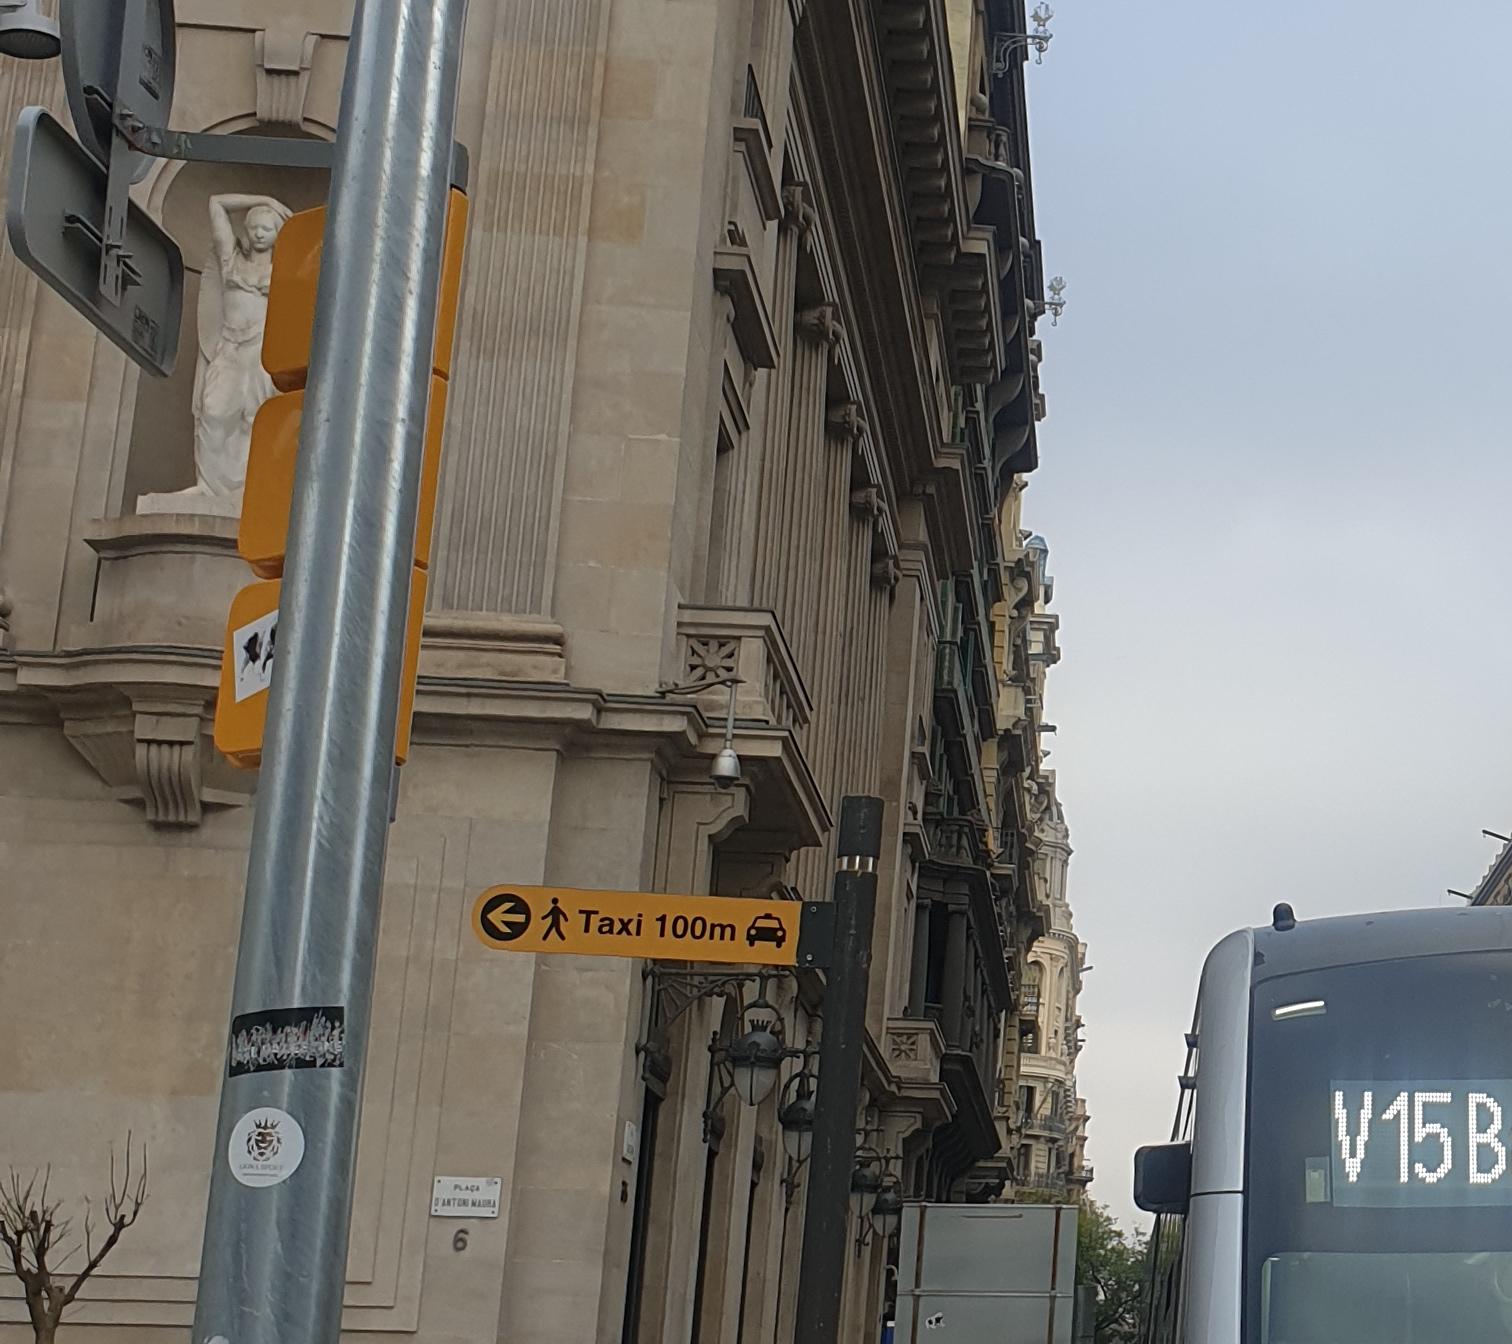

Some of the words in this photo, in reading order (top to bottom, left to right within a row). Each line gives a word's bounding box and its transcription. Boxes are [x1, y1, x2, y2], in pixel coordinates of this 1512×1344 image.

[577, 909, 644, 937] Taxi
[655, 913, 736, 942] 100m
[1333, 1090, 1453, 1184] V15
[453, 1183, 480, 1193] PLAÇA
[452, 1228, 469, 1253] 6
